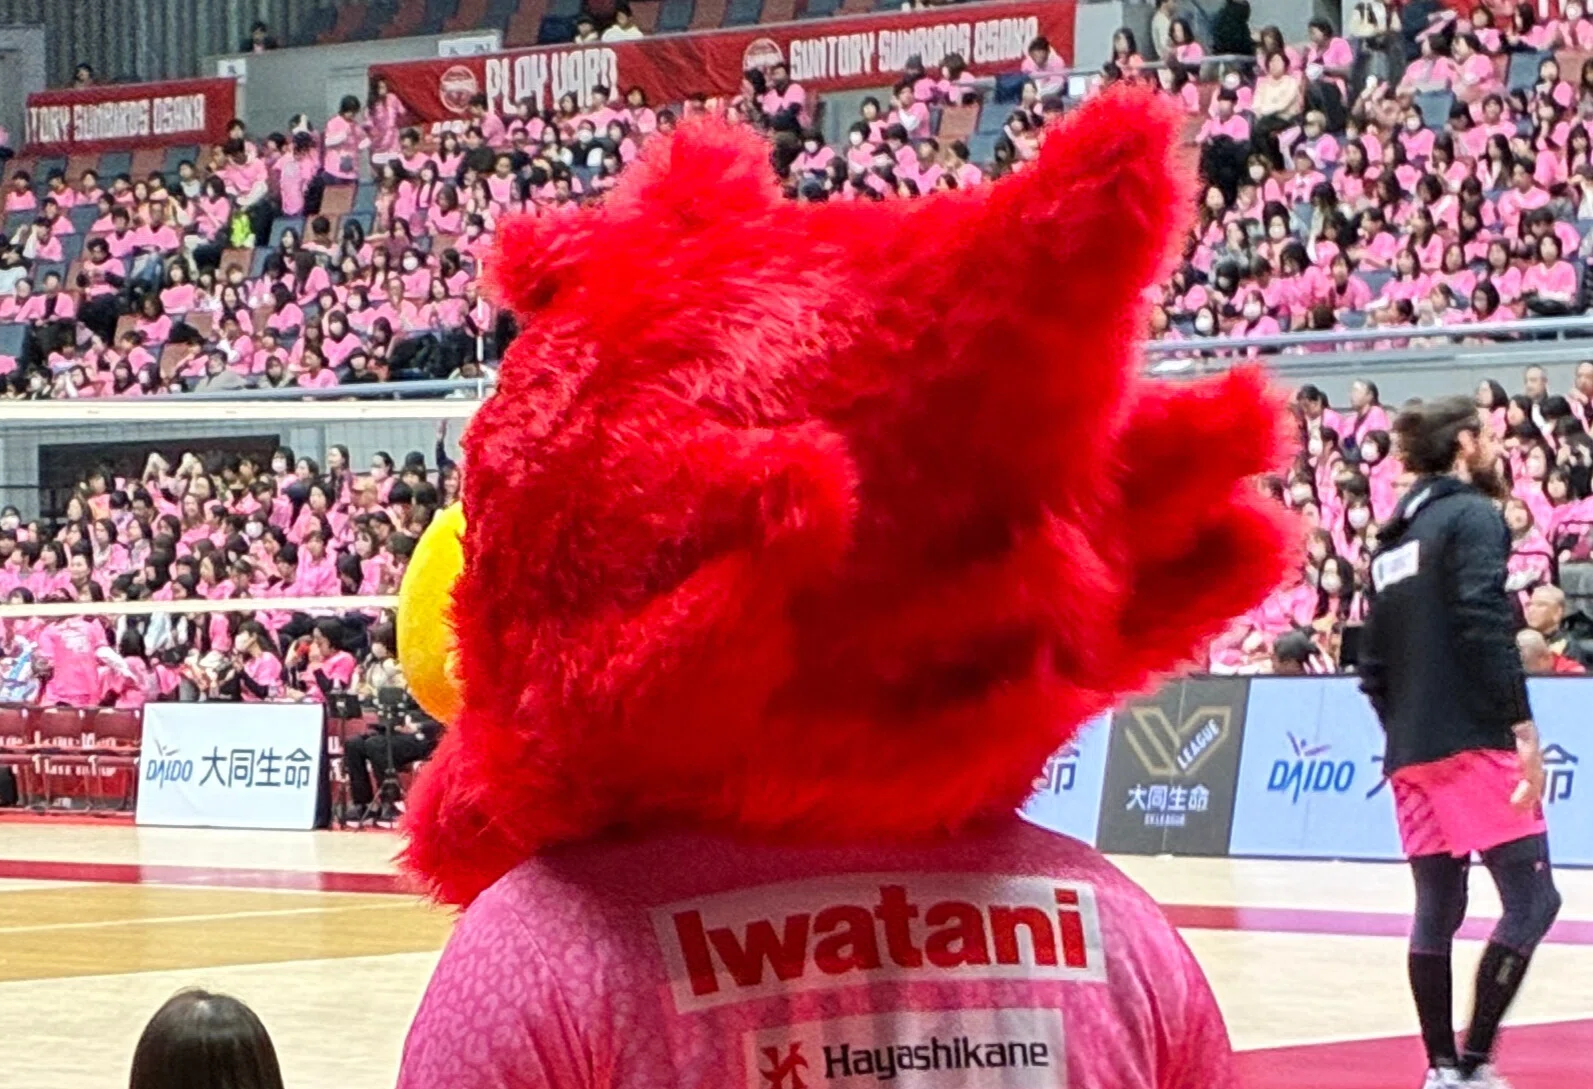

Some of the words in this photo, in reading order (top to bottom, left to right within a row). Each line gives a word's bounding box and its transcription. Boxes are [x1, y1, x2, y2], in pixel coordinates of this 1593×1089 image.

[789, 31, 875, 81] SUNTORY
[1177, 718, 1220, 770] LEAGUE
[145, 759, 193, 790] DAIDO
[199, 746, 313, 789] 大同生命
[1267, 759, 1356, 804] DAIDO
[1126, 783, 1210, 812] 大同生命
[672, 884, 1088, 996] Iwatani
[822, 1035, 1050, 1080] Hayashikane
